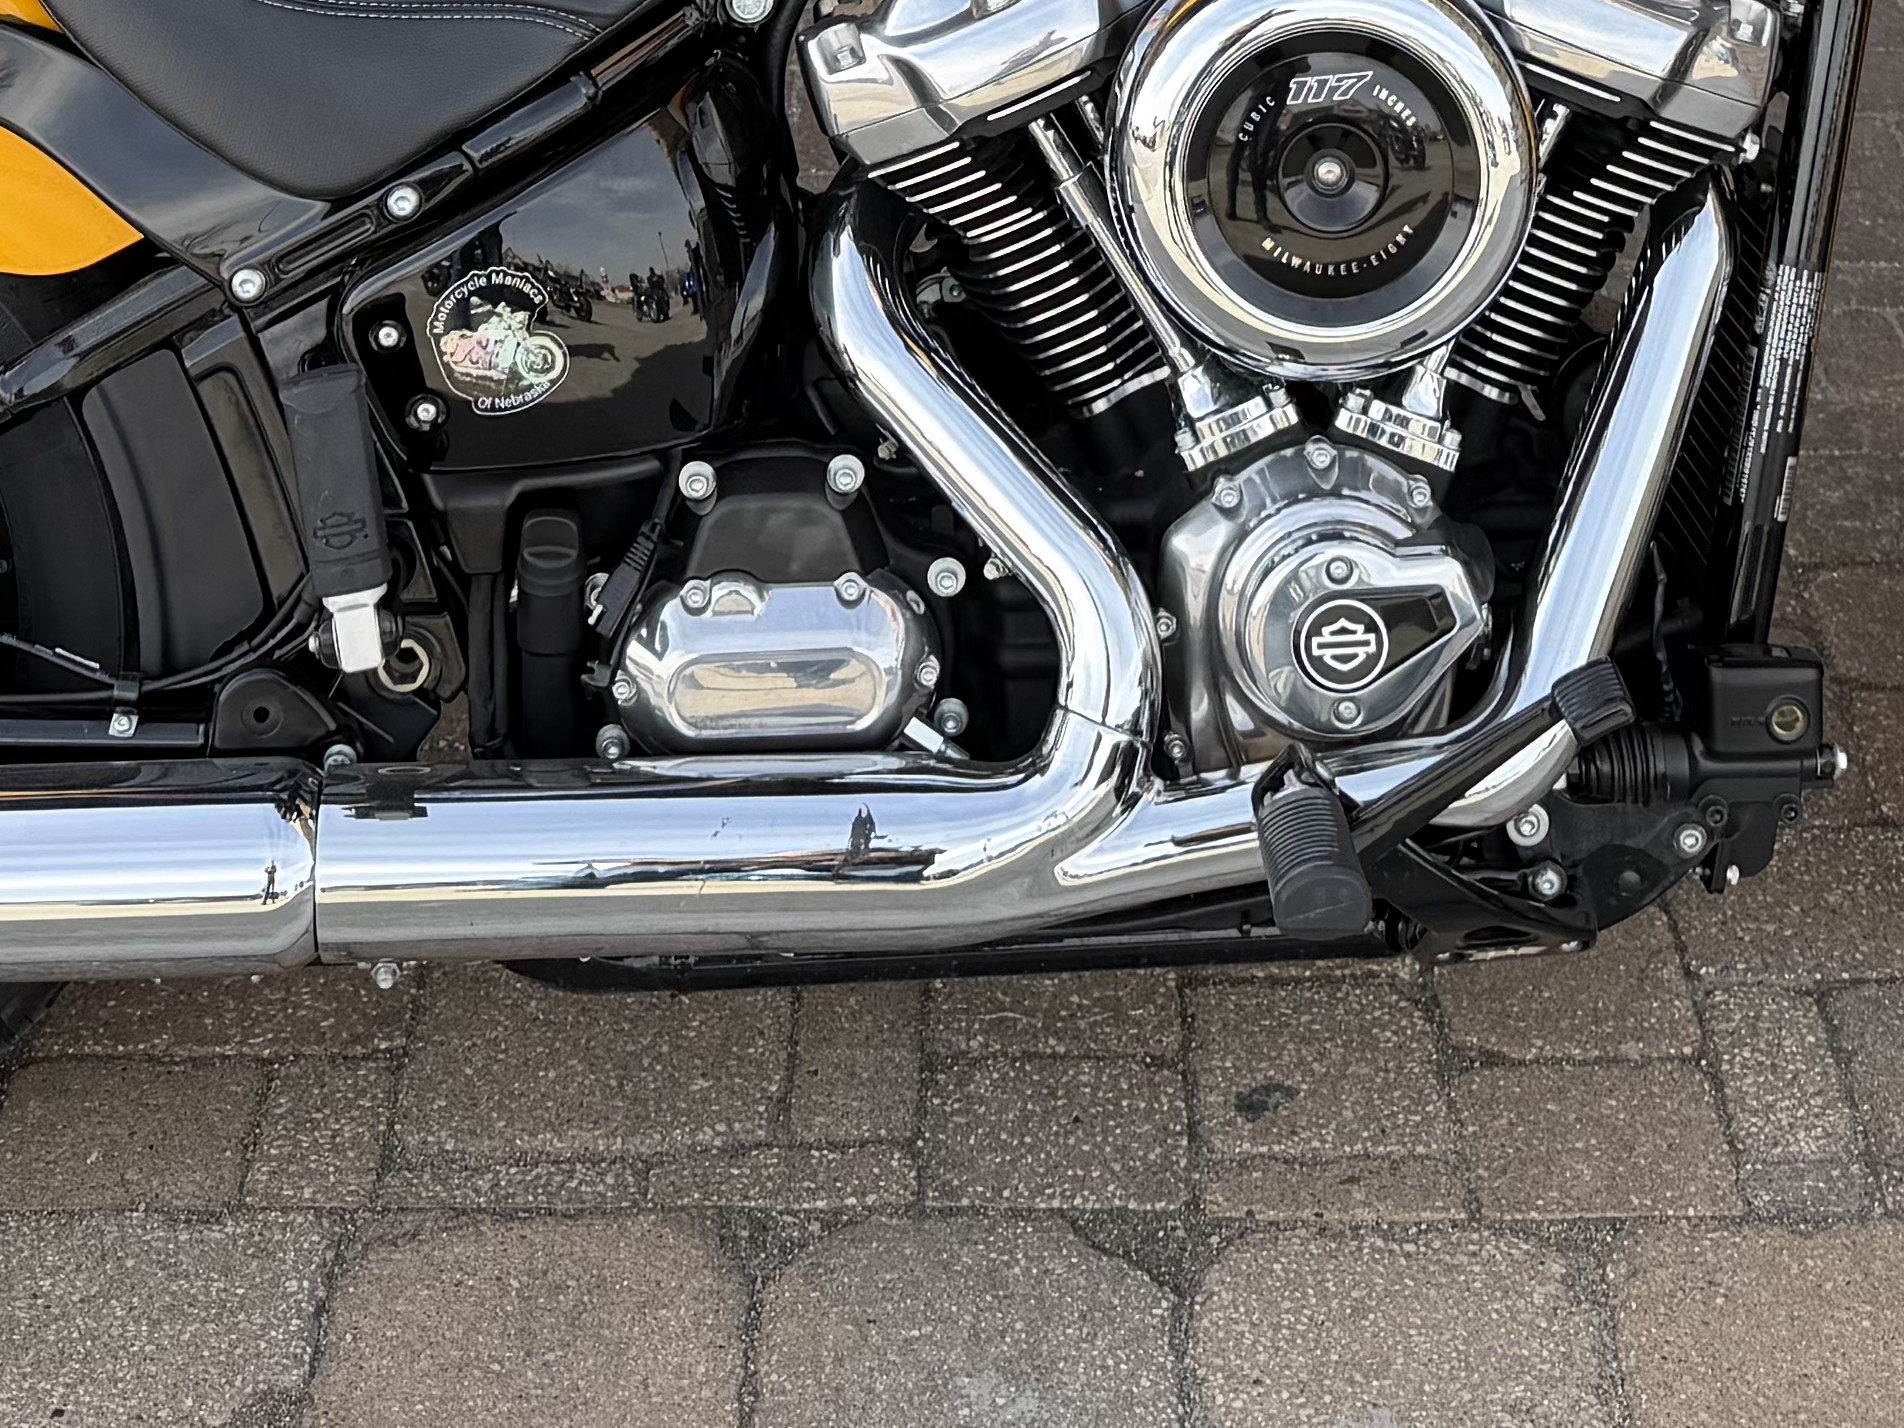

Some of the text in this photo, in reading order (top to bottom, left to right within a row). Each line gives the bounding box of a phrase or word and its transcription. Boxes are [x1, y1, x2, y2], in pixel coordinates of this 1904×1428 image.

[1238, 69, 1418, 143] CUBIC 117 INCHES
[432, 271, 544, 335] Motorcycle Maniacs
[477, 380, 551, 410] Of Nebraska
